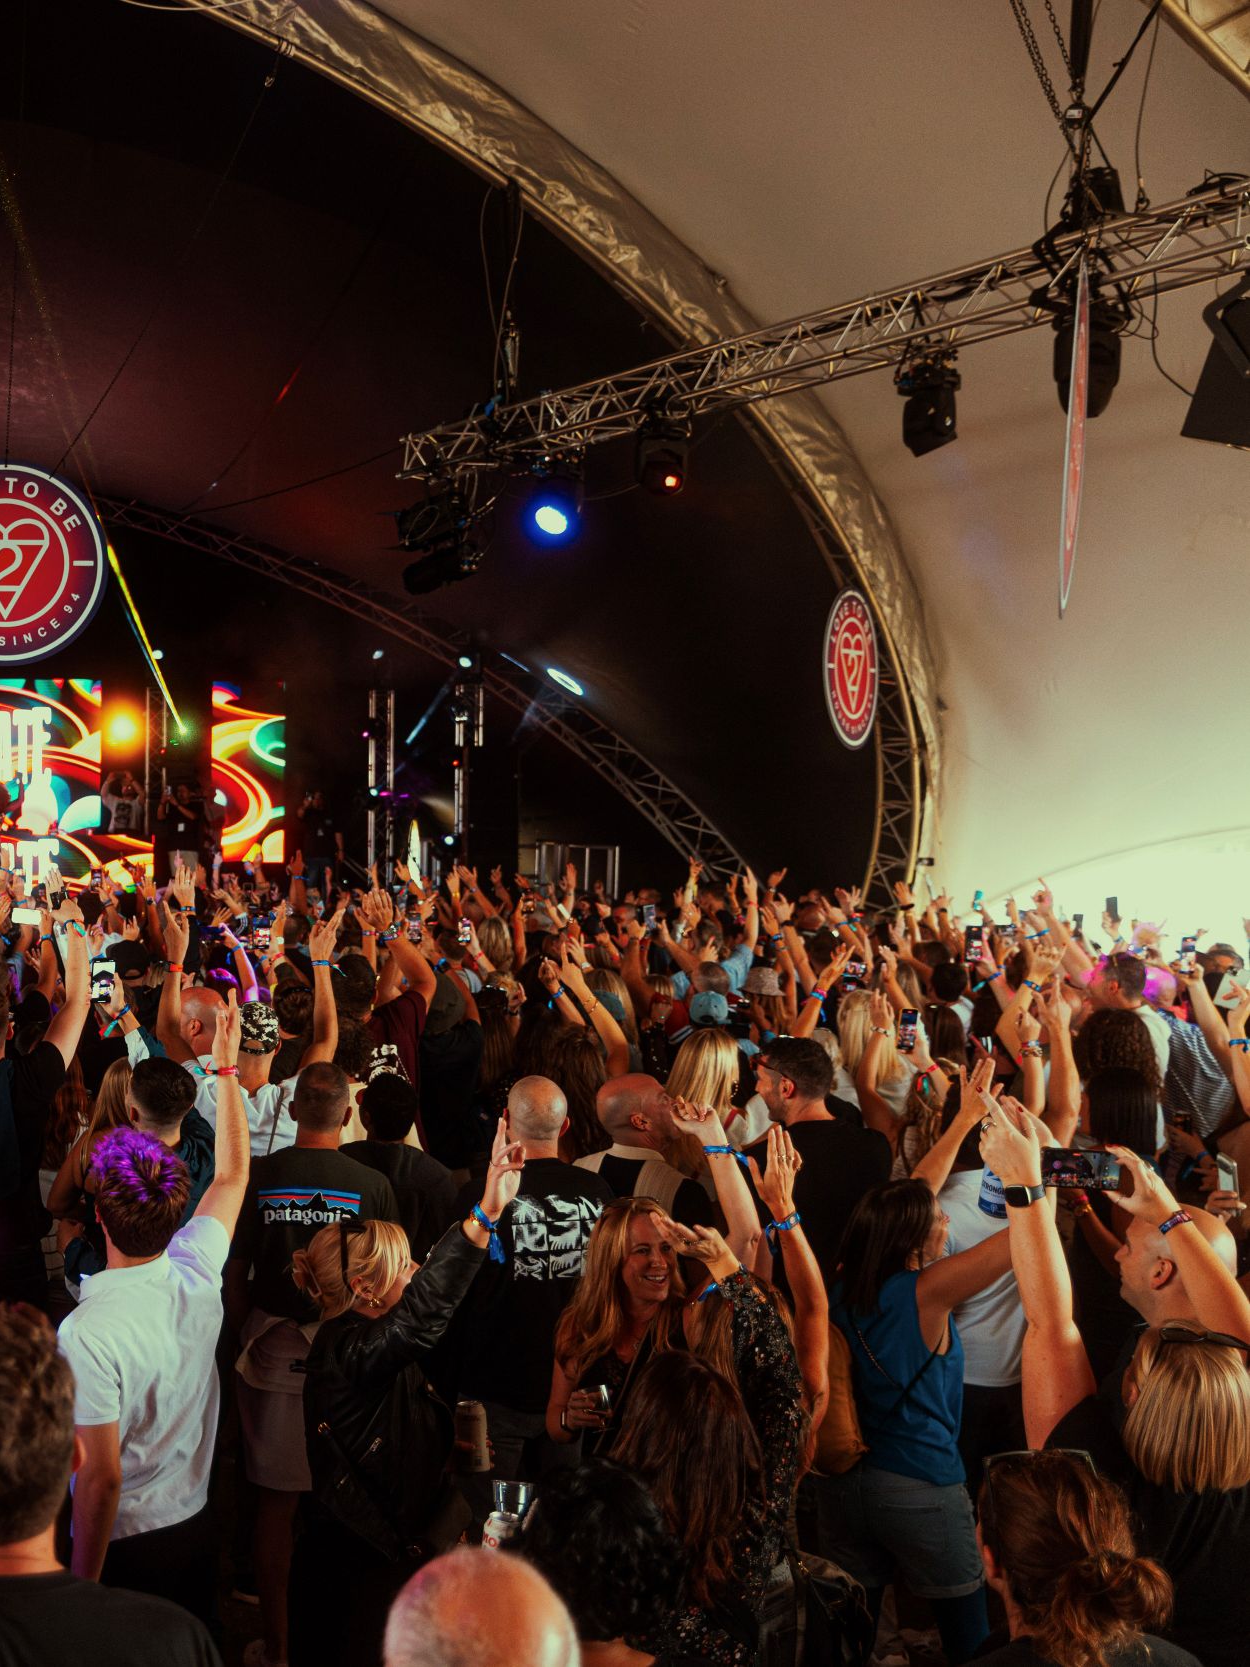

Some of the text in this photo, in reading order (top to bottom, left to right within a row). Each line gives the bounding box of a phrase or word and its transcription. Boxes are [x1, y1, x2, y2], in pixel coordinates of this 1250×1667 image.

[5, 477, 40, 498] TO
[50, 497, 82, 532] BE
[830, 602, 849, 643] LOVE
[852, 601, 863, 618] TO
[264, 1206, 351, 1225] patagoni
